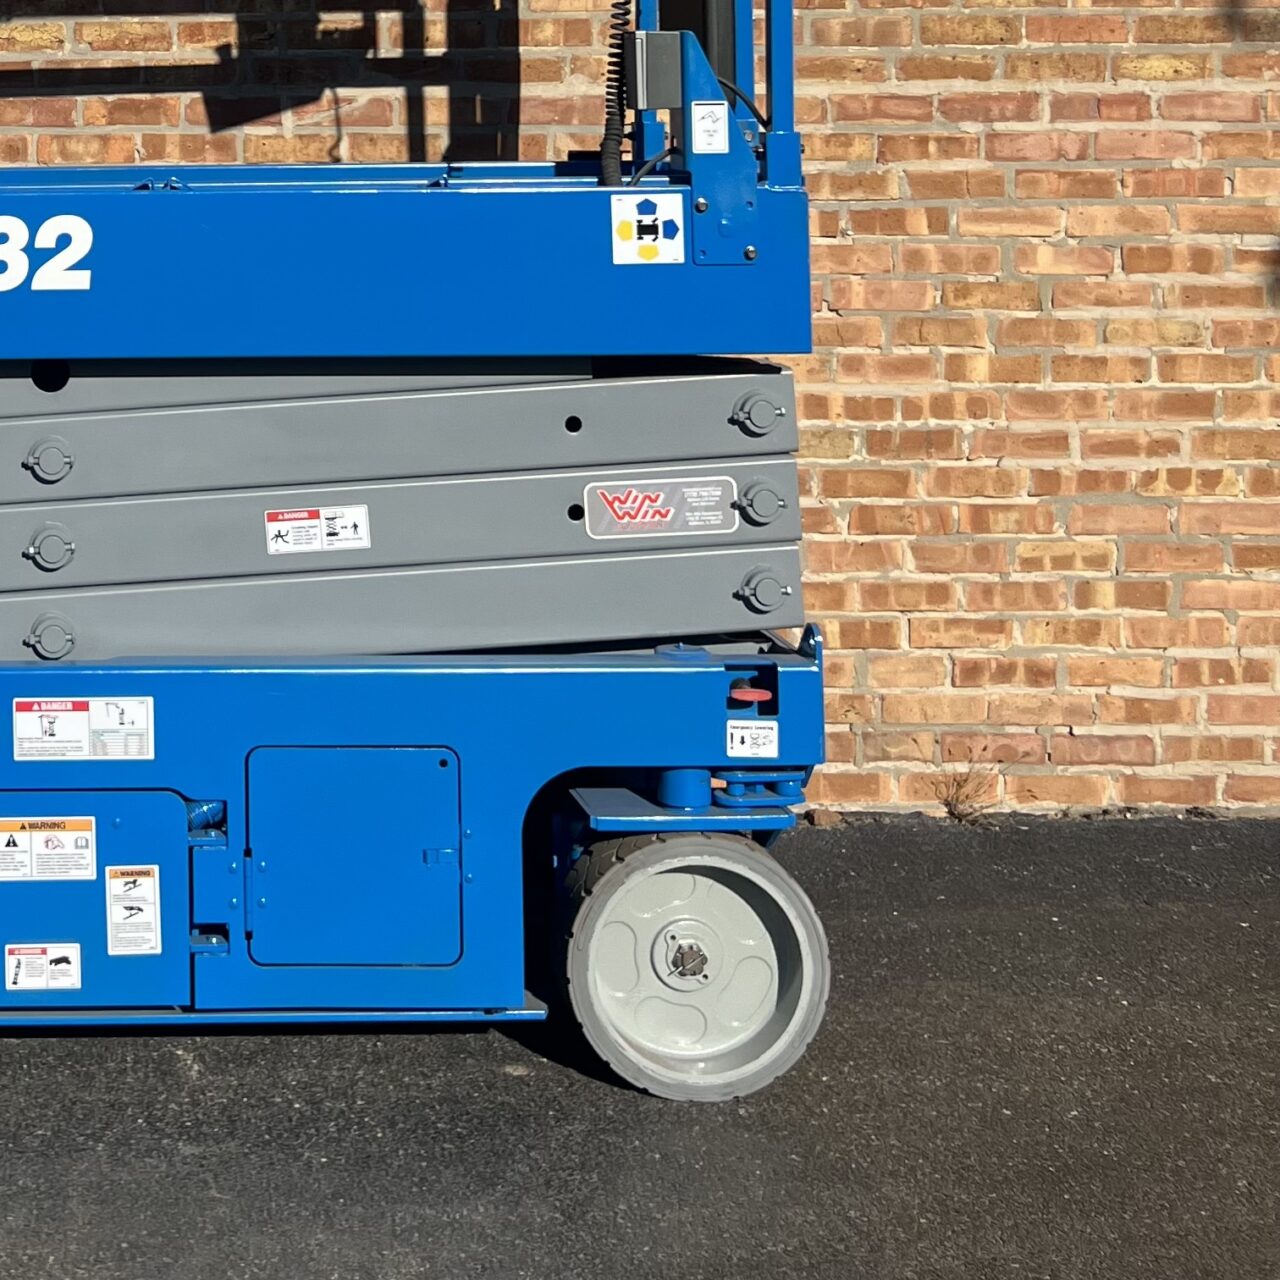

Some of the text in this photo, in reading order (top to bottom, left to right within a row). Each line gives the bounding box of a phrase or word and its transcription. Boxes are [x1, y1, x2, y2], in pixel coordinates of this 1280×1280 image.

[283, 512, 309, 520] DANGER
[40, 701, 73, 711] DANGER
[28, 821, 66, 830] WARNING
[120, 869, 151, 877] WARNING
